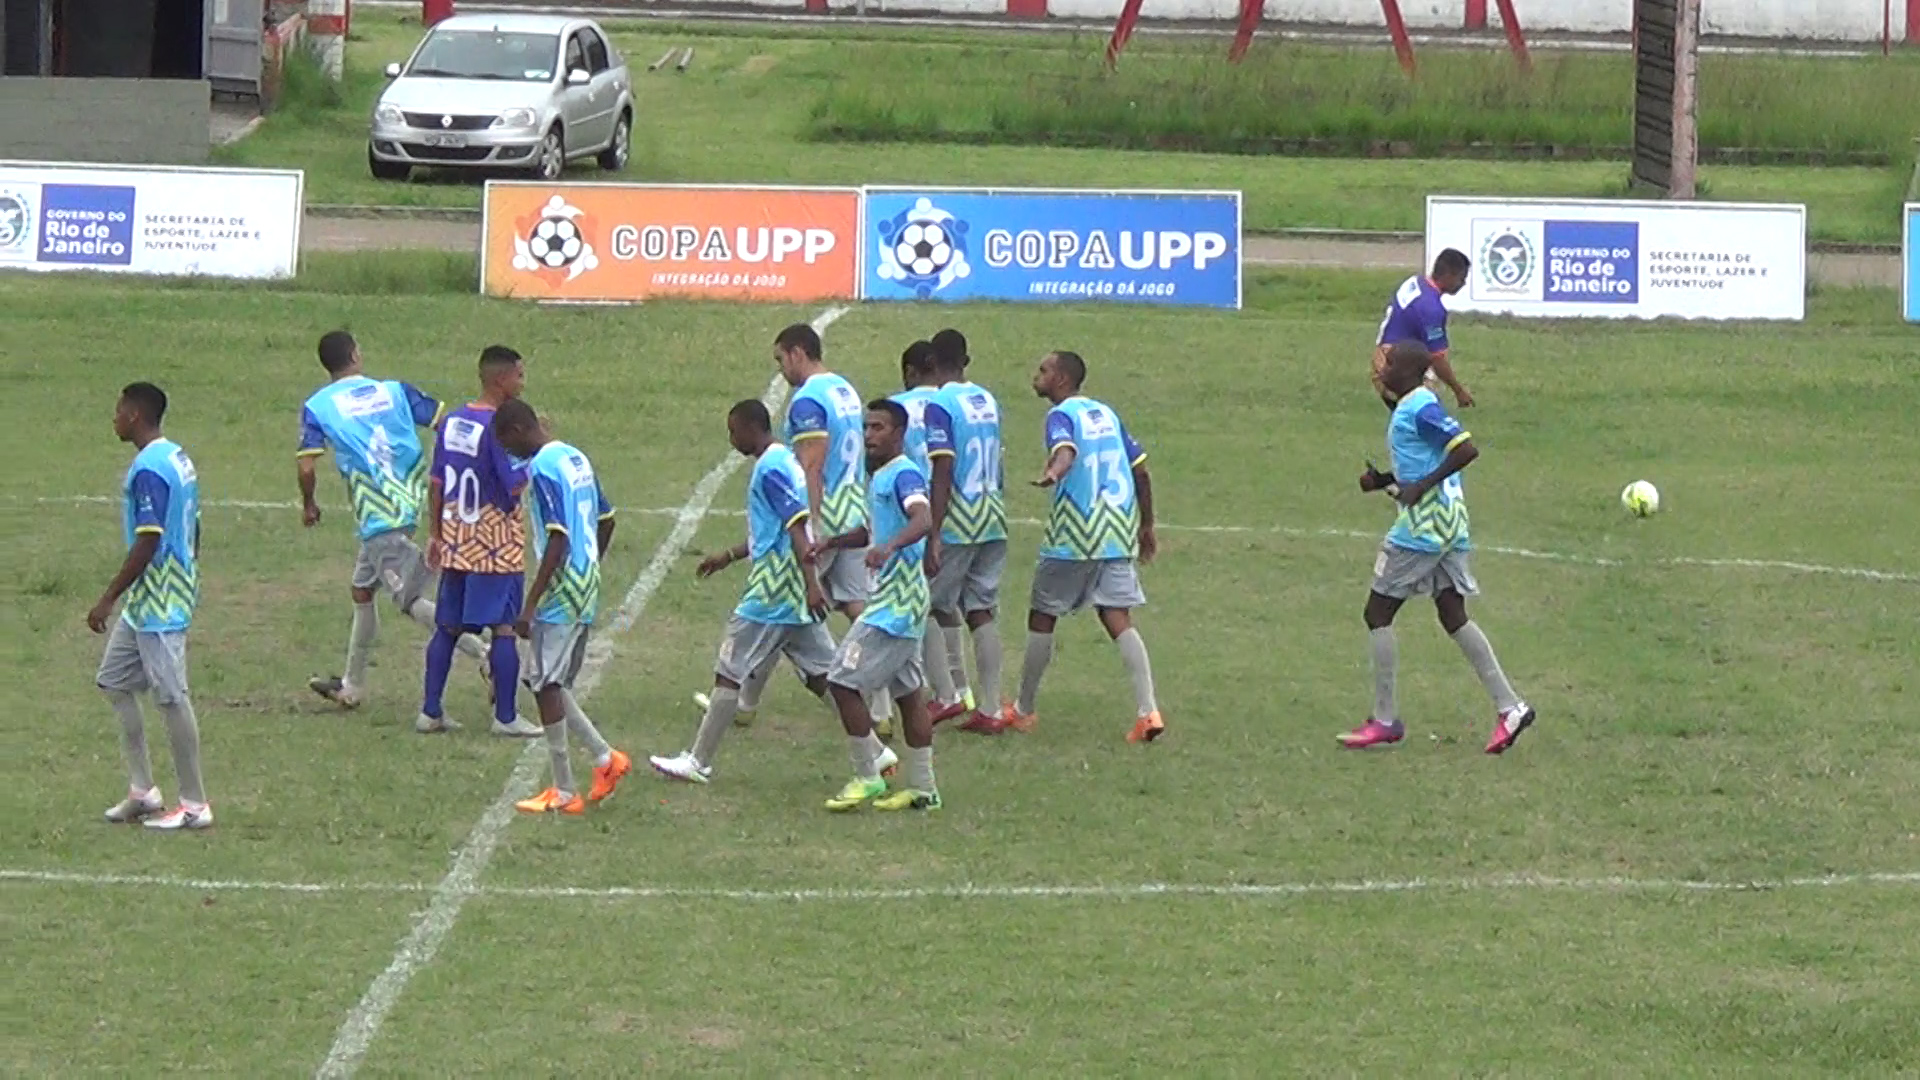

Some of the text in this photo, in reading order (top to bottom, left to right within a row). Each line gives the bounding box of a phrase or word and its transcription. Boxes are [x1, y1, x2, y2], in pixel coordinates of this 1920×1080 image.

[46, 209, 126, 222] GOVERNO DO
[145, 214, 245, 226] SECRETARIA DE
[45, 220, 110, 238] Rio de
[209, 230, 249, 240] LAZER
[43, 236, 126, 256] Janeiro
[1549, 247, 1631, 259] GOVERNO DO
[1649, 251, 1751, 264] SECRETARIA DE
[1550, 258, 1615, 276] Rio de
[1716, 266, 1758, 276] LAZER
[1761, 267, 1768, 277] E
[1029, 280, 1114, 298] INTEGRAÇÃO
[1138, 282, 1176, 297] JOGO
[1549, 275, 1632, 294] Janeiro
[1650, 278, 1725, 290] JUVENTUDE
[840, 429, 861, 485] 9
[962, 436, 999, 492] 20
[1083, 450, 1128, 507] 13
